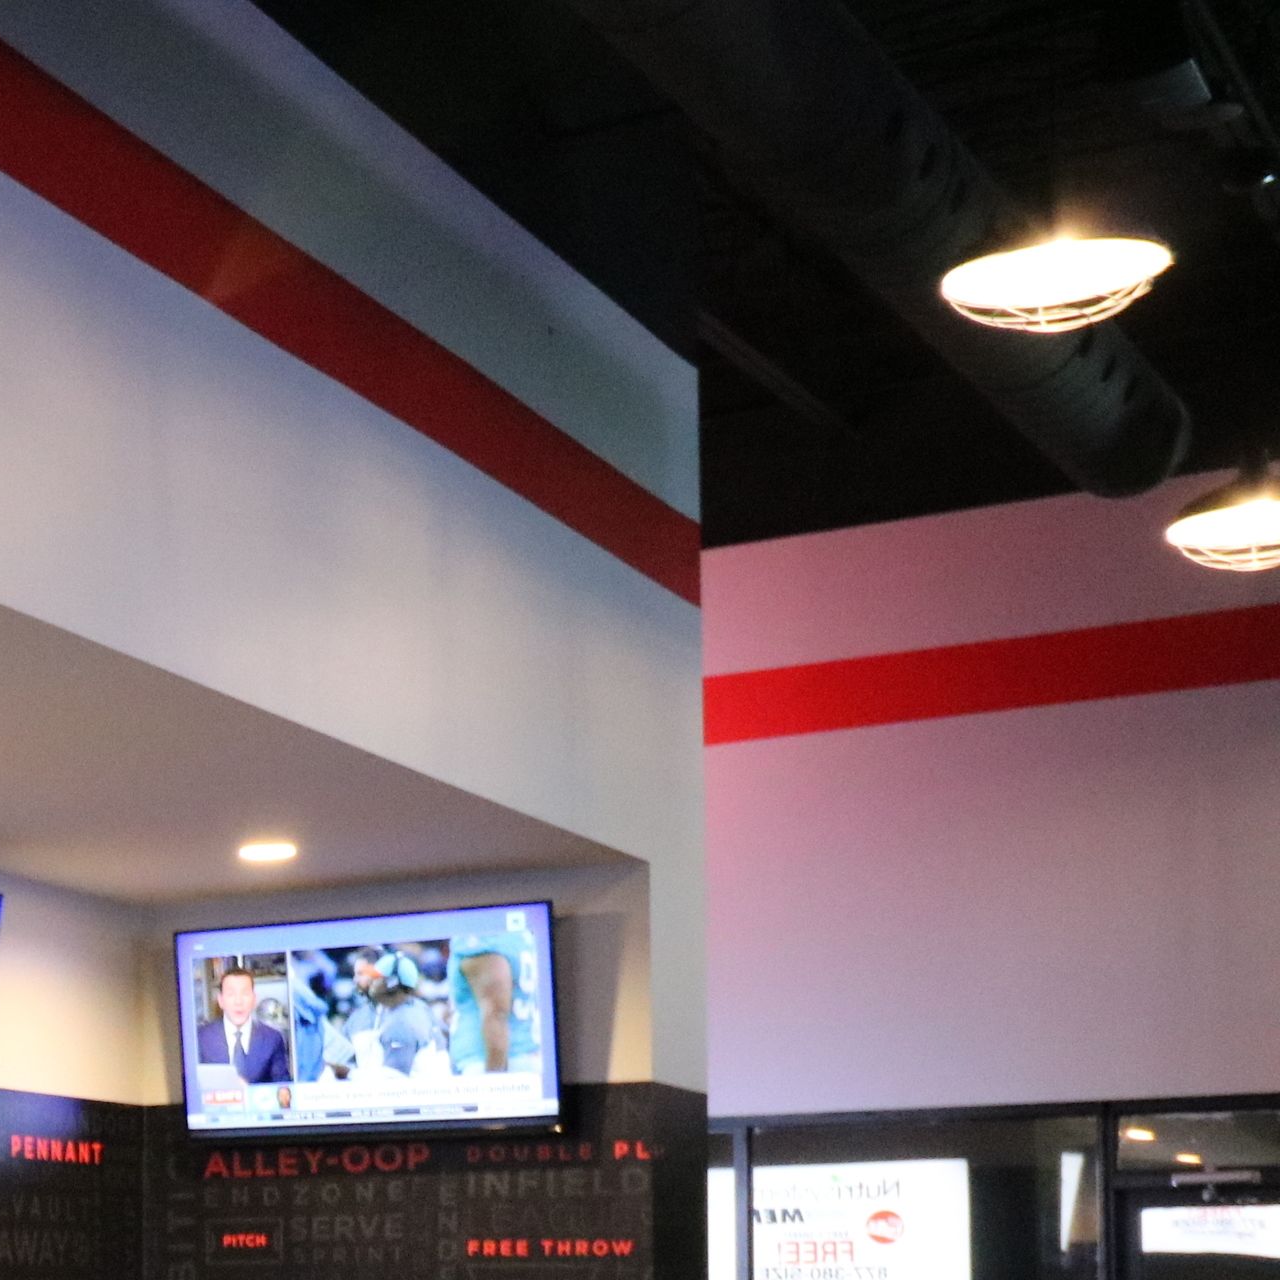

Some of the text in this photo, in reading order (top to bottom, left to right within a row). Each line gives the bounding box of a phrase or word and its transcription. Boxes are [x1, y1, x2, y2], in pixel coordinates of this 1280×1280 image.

[9, 1133, 103, 1166] PENNANT
[203, 1144, 431, 1180] ALLEY-OOP
[466, 1239, 635, 1257] FREE THROW
